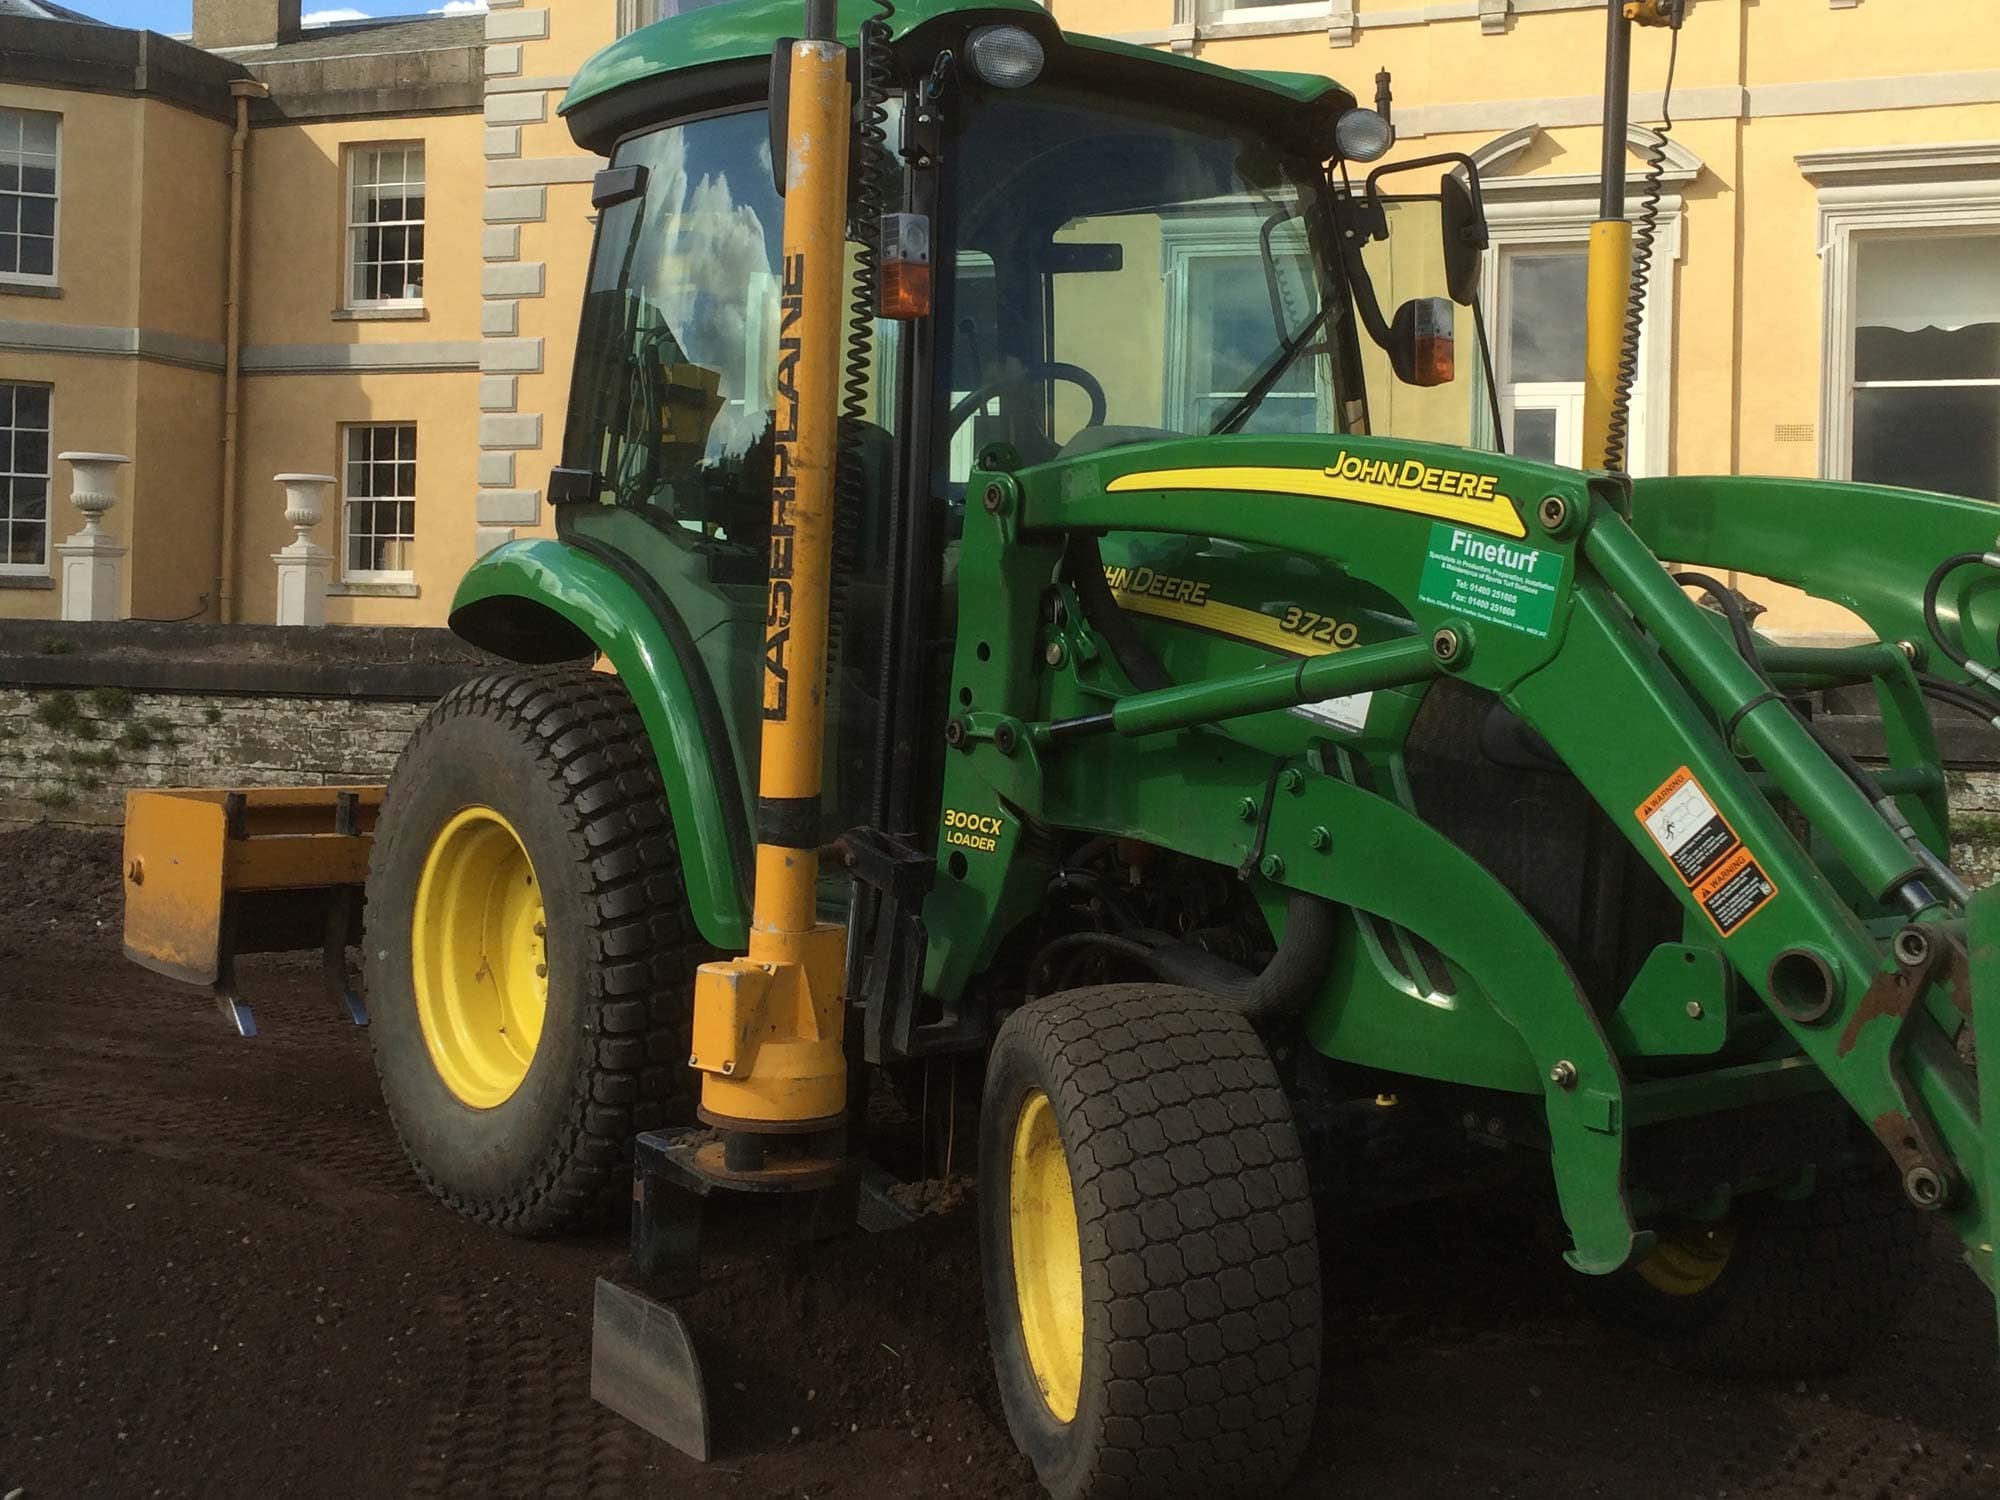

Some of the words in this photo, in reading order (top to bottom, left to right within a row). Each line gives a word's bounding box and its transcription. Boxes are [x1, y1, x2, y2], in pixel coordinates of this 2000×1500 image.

[762, 253, 804, 721] LASERPLANE
[1324, 451, 1399, 485] JOHN
[1399, 460, 1498, 498] DEERE
[1450, 530, 1539, 573] Fineturf
[1131, 567, 1210, 605] DEERE
[1280, 607, 1359, 646] 3720
[1651, 774, 1685, 808] WARNING
[944, 809, 1003, 835] 300CX
[946, 830, 996, 852] LOADER
[1710, 855, 1747, 889] WARNING
